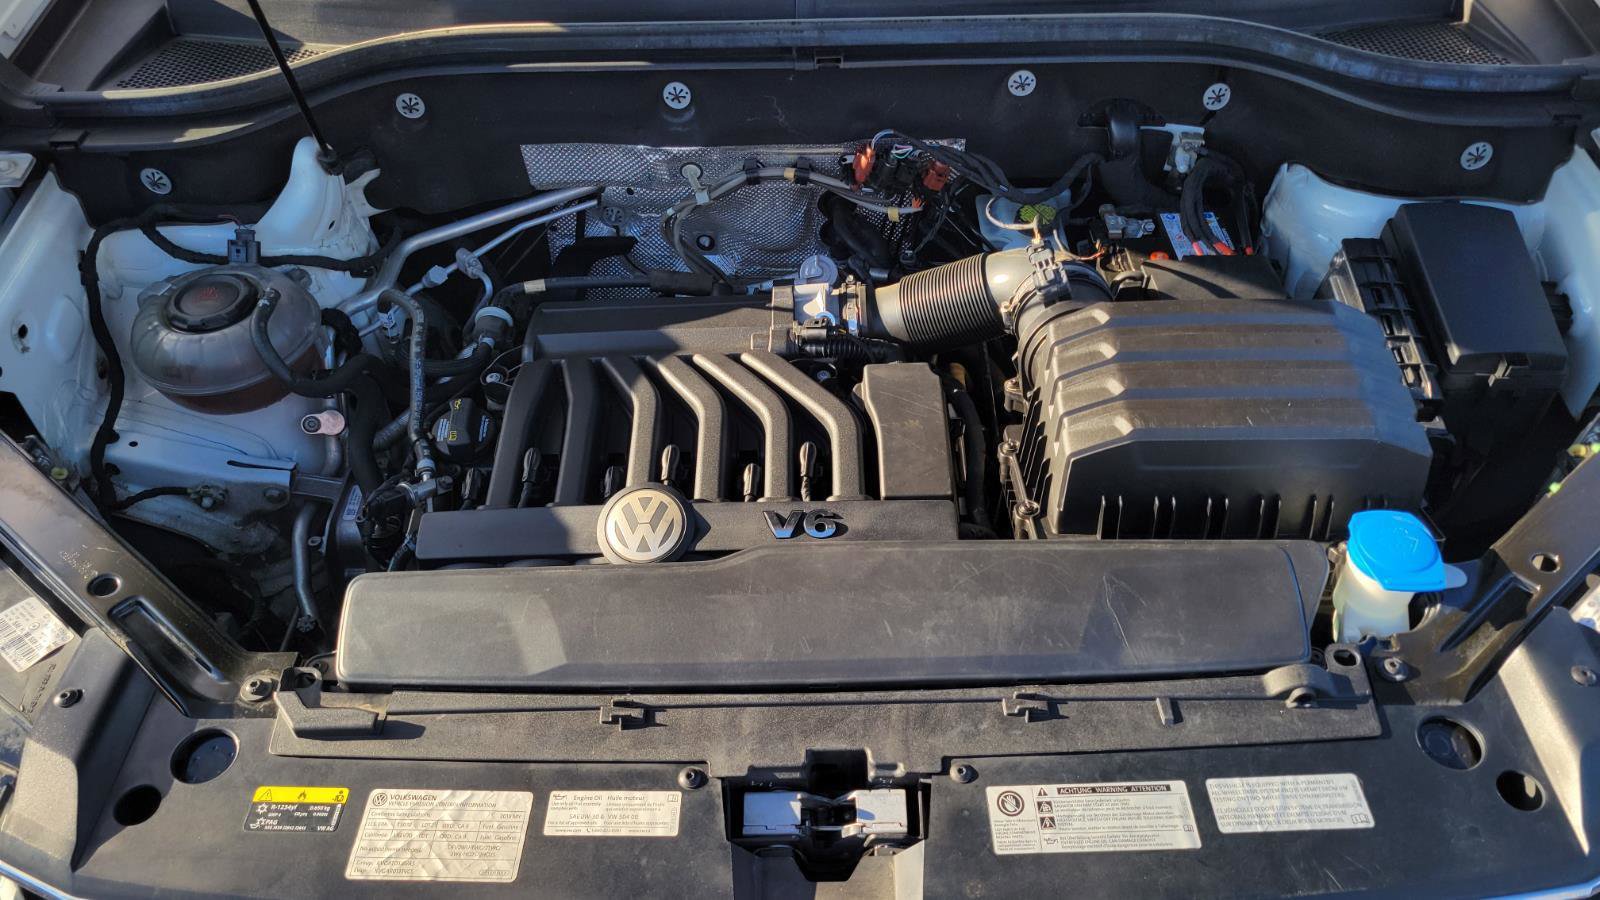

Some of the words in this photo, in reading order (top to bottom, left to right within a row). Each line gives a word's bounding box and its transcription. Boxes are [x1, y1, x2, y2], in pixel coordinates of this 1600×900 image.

[763, 508, 843, 540] V6
[1059, 786, 1093, 795] ACHTUNG
[1095, 785, 1128, 793] WARNING
[1130, 784, 1168, 792] ATTENTION
